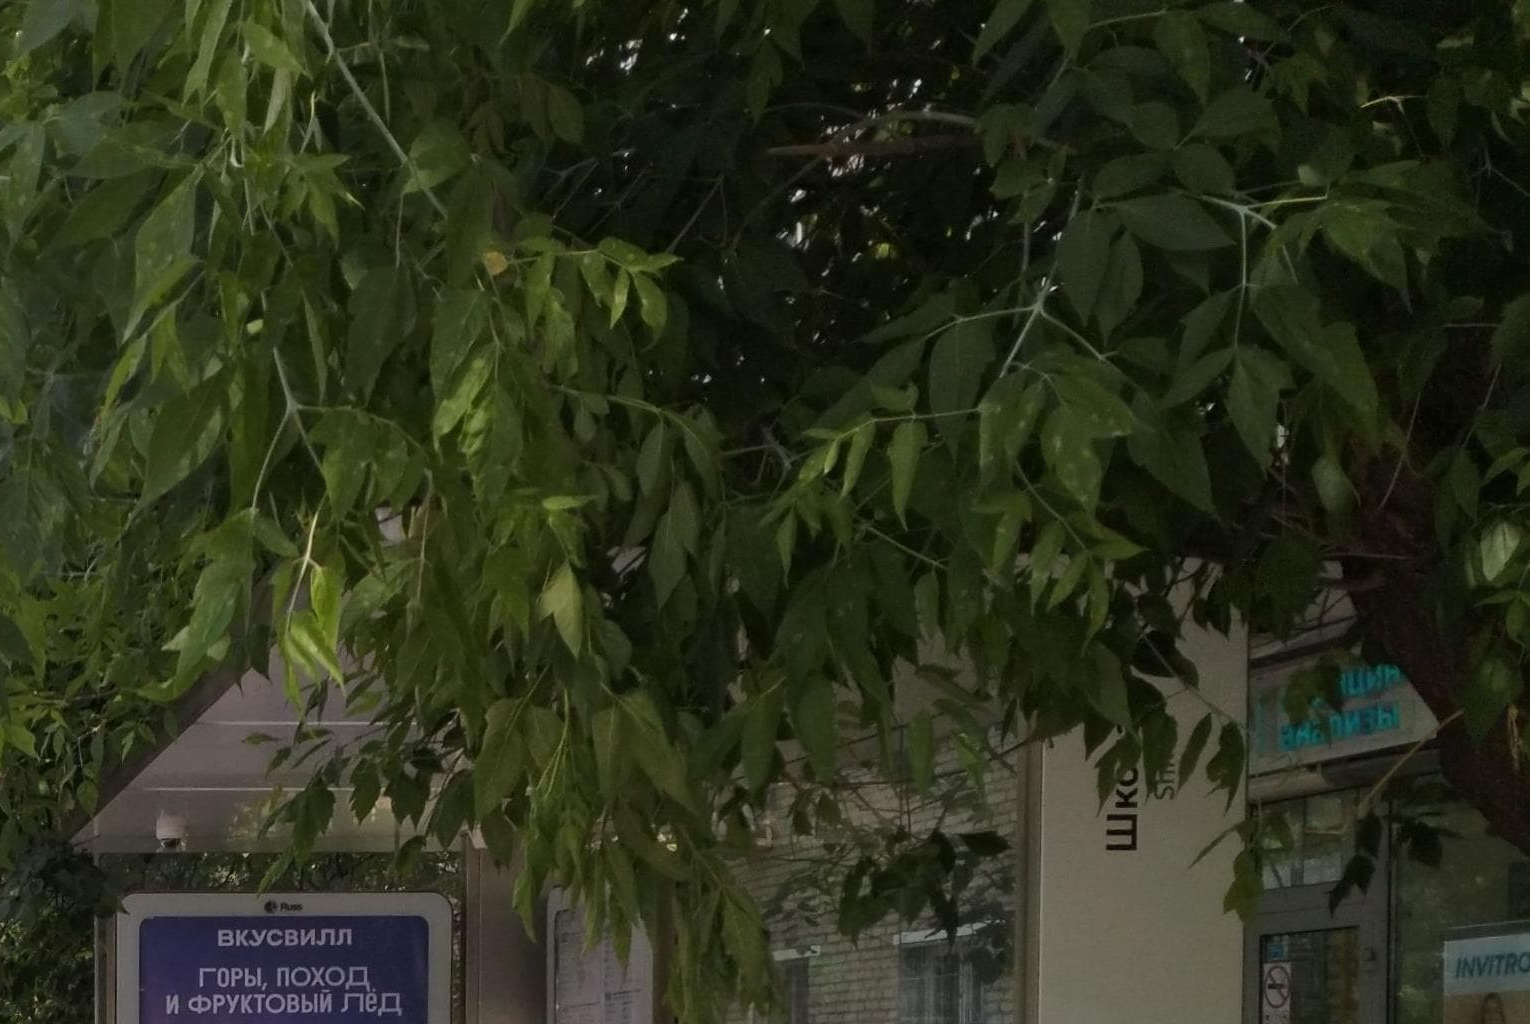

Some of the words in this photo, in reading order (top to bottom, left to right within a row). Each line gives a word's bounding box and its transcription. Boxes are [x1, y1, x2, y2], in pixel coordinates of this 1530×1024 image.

[217, 928, 352, 947] ВКУСВИЛЛ
[199, 967, 268, 991] ГОРЫ,
[277, 966, 370, 992] ПОХОД
[166, 994, 179, 1014] И
[188, 989, 333, 1014] ФРУКТОВЫЙ
